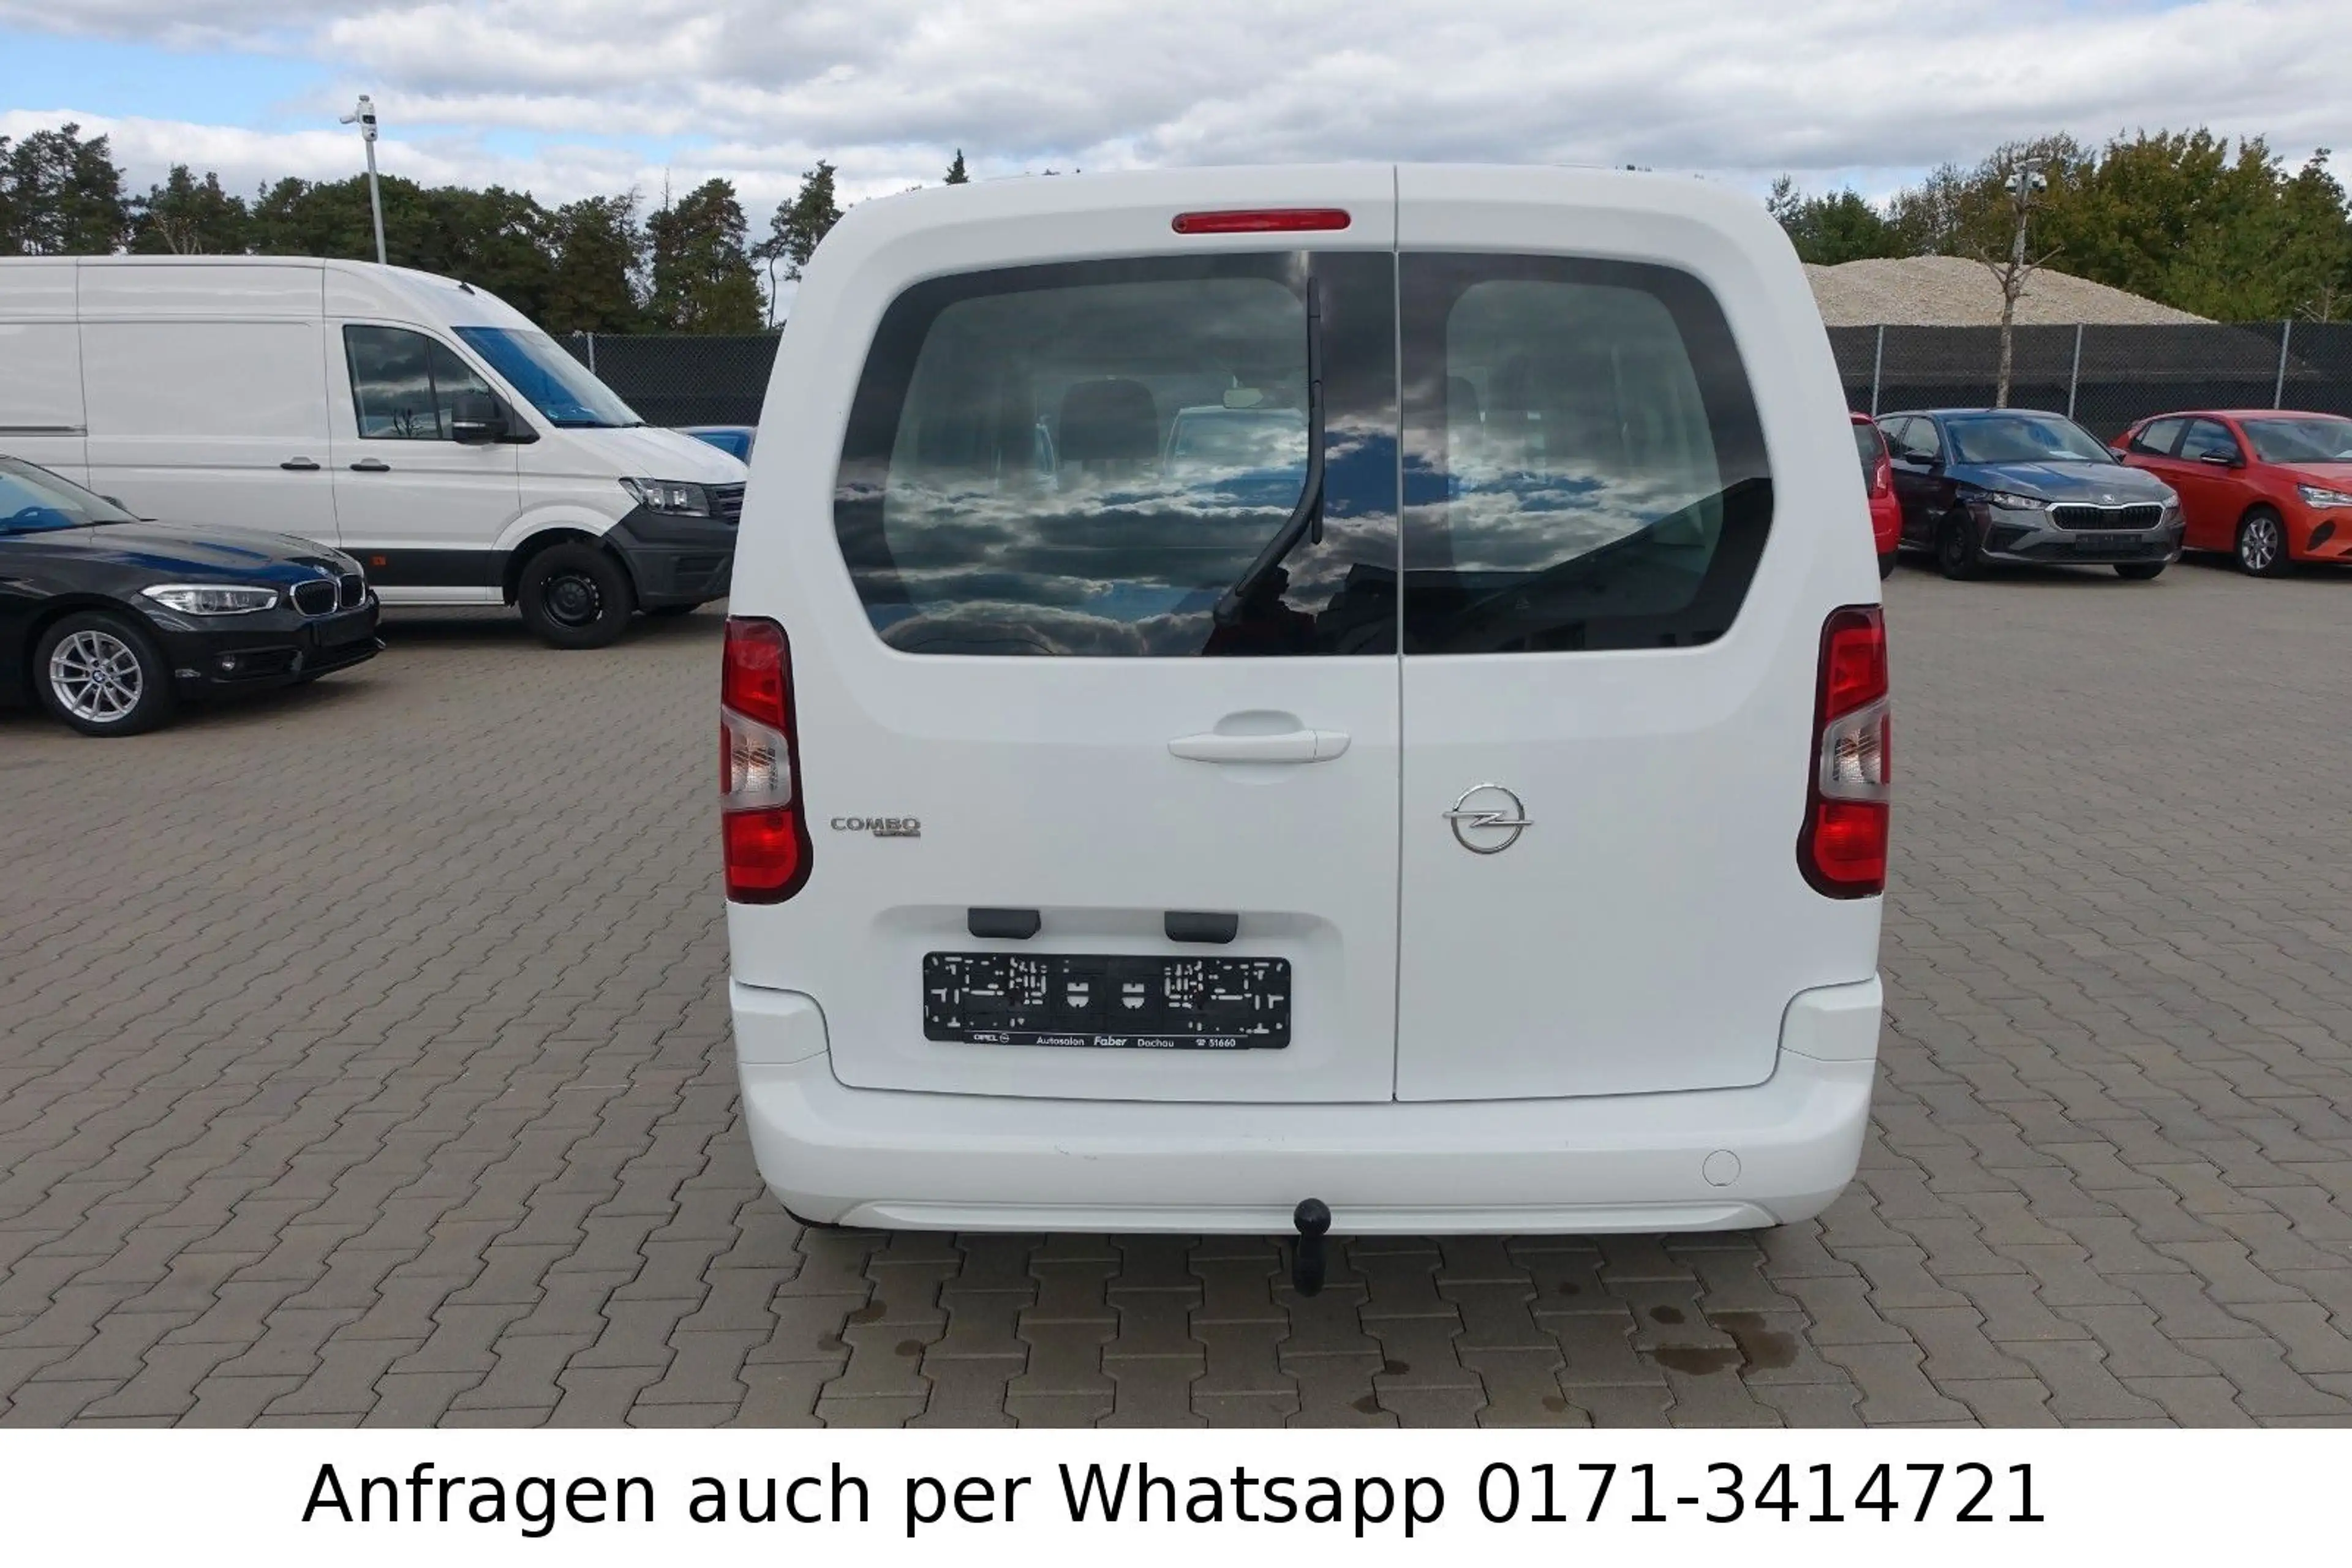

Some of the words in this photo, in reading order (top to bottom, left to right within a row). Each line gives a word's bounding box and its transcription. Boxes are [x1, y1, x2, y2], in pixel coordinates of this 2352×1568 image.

[831, 818, 921, 831] COMBO
[1036, 1036, 1085, 1046] Autosalon
[1093, 1036, 1128, 1046] Faber
[1137, 1038, 1175, 1047] Dachau
